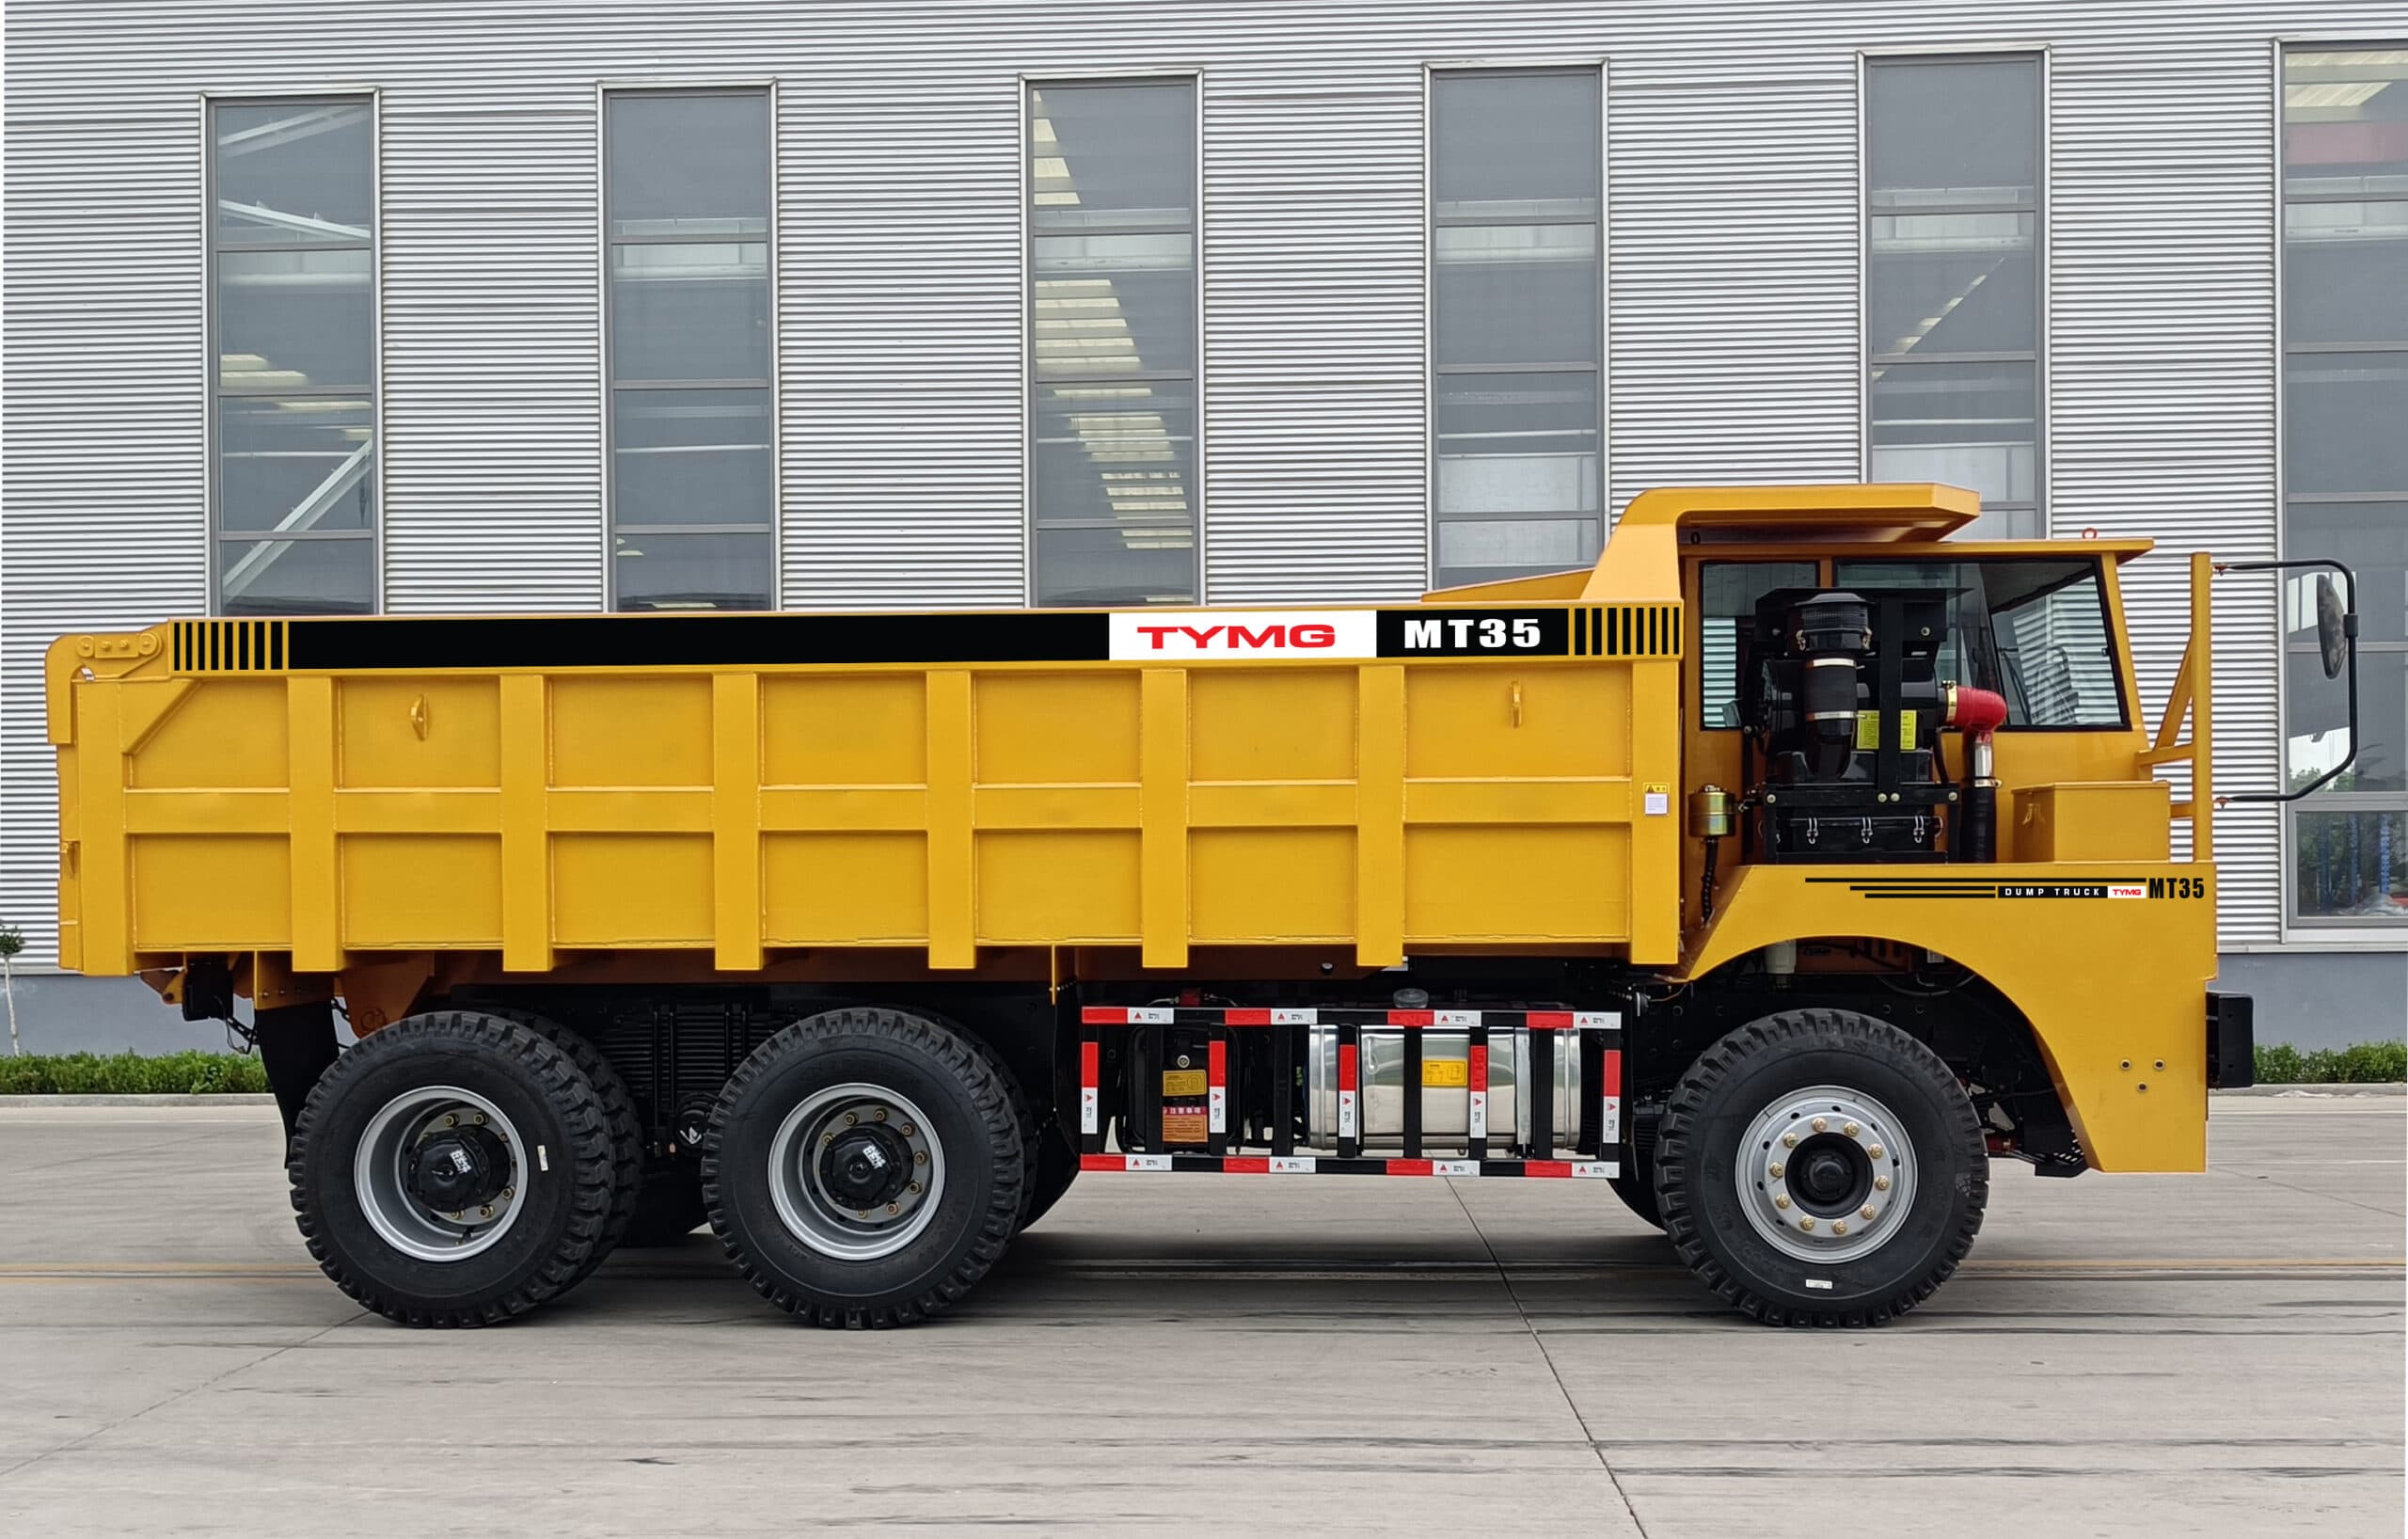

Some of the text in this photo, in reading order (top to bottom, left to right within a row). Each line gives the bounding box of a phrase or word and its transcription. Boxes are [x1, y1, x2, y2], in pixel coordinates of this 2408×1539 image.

[1136, 624, 1336, 649] TYMG
[1402, 618, 1542, 649] MT35
[2004, 887, 2100, 896] DUMP TRUCK
[2112, 888, 2142, 896] TYMG
[2148, 877, 2205, 899] MT35
